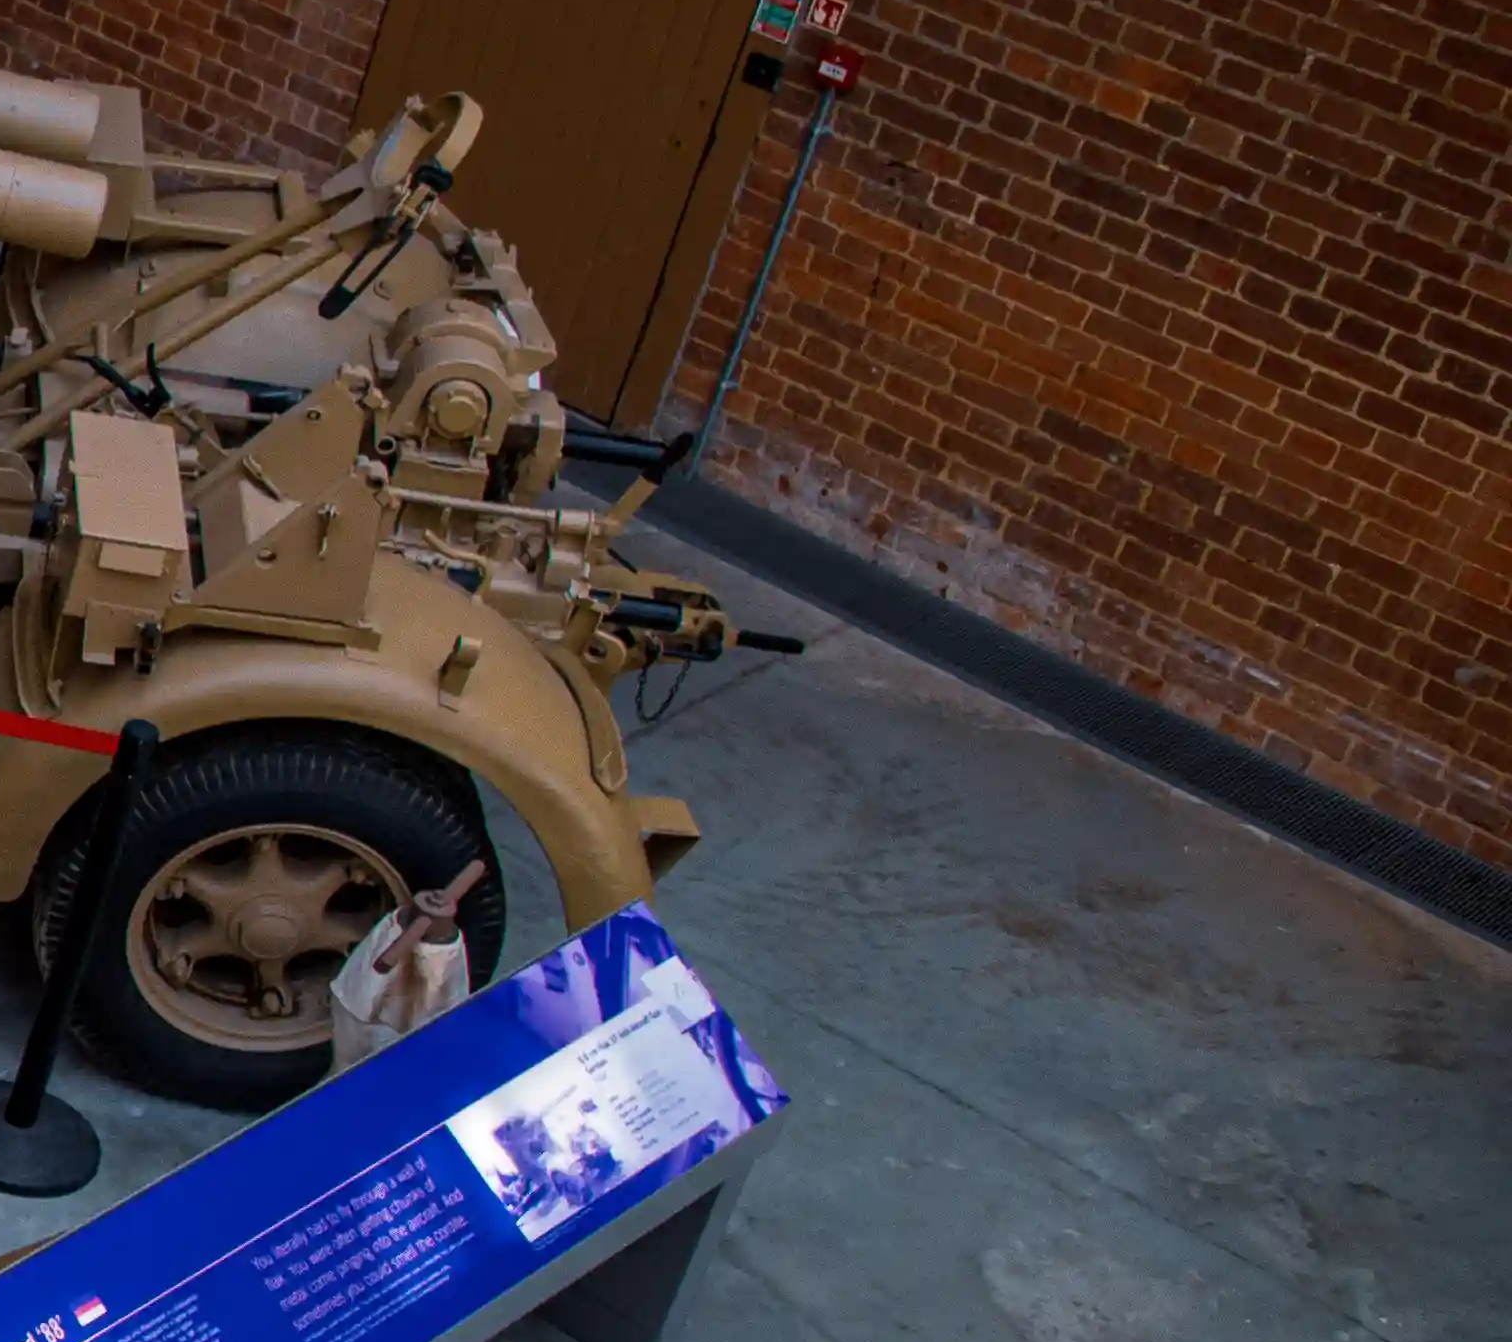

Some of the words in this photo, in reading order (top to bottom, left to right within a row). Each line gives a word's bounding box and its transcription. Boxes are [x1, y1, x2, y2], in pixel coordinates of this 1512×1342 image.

[250, 1254, 274, 1270] You
[271, 1232, 308, 1259] literally
[305, 1217, 328, 1237] had
[324, 1212, 340, 1226] to
[350, 1181, 389, 1209] through
[395, 1163, 416, 1182] wall
[413, 1155, 427, 1171] of
[279, 1286, 308, 1310] metal
[307, 1270, 337, 1293] come
[371, 1235, 392, 1252] into
[388, 1224, 408, 1241] the
[441, 1187, 464, 1207] And
[287, 1260, 309, 1275] You
[308, 1243, 333, 1264] were
[331, 1227, 358, 1249] often
[358, 1207, 393, 1236] getting
[388, 1187, 425, 1215] chunks
[423, 1175, 436, 1192] of
[292, 1291, 346, 1331] sometimes
[345, 1282, 365, 1300] you
[363, 1259, 393, 1285] could
[390, 1243, 418, 1268] smell
[414, 1235, 435, 1252] the
